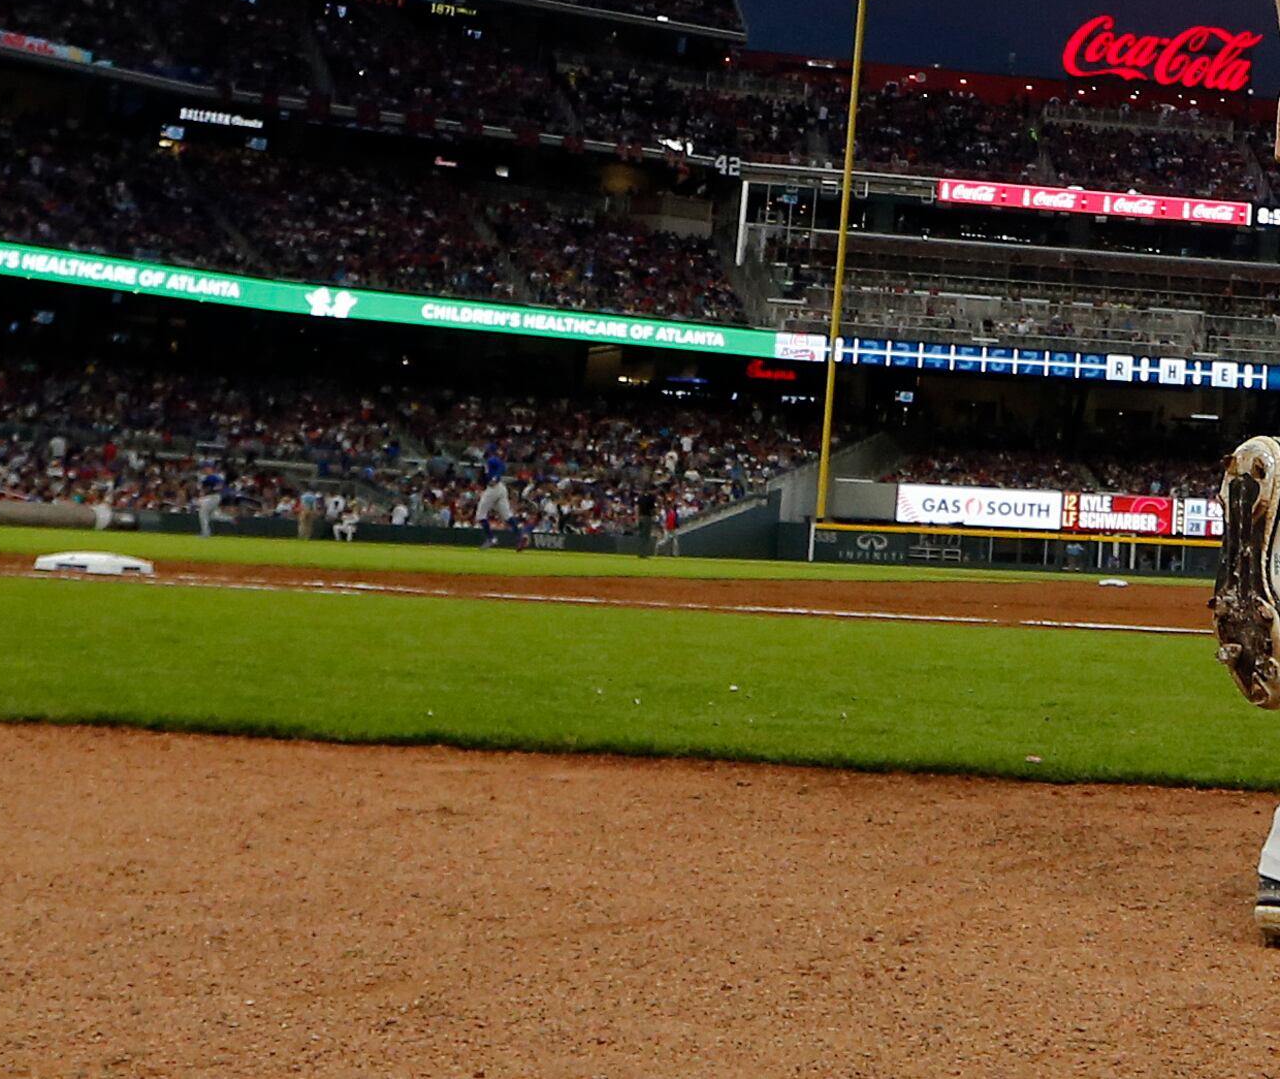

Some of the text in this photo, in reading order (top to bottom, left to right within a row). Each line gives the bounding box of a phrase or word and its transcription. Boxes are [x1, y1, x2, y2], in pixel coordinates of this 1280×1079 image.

[431, 3, 456, 17] 1871
[1062, 15, 1263, 91] Coca-Cola
[714, 155, 741, 177] 42
[952, 183, 996, 202] Coca-Cola
[1032, 190, 1077, 208] Coca-Cola
[1113, 197, 1157, 215] Coca-Cola
[1192, 203, 1236, 221] Coca-Cola
[21, 250, 136, 285] HEALTHCARE
[138, 268, 166, 288] OF
[166, 272, 241, 299] ATLANTA
[421, 303, 726, 347] CHILDREN'S HEALTHCARE OF ATLANTA
[925, 345, 944, 367] 4
[959, 347, 975, 369] 5
[1115, 362, 1124, 376] R
[1168, 365, 1177, 379] H
[1221, 368, 1229, 383] E
[922, 498, 1050, 518] GAS SOUTH
[1064, 495, 1112, 512] 12 KYLE
[1062, 511, 1157, 532] LF SCHWARBER
[839, 551, 904, 560] INFINITI
